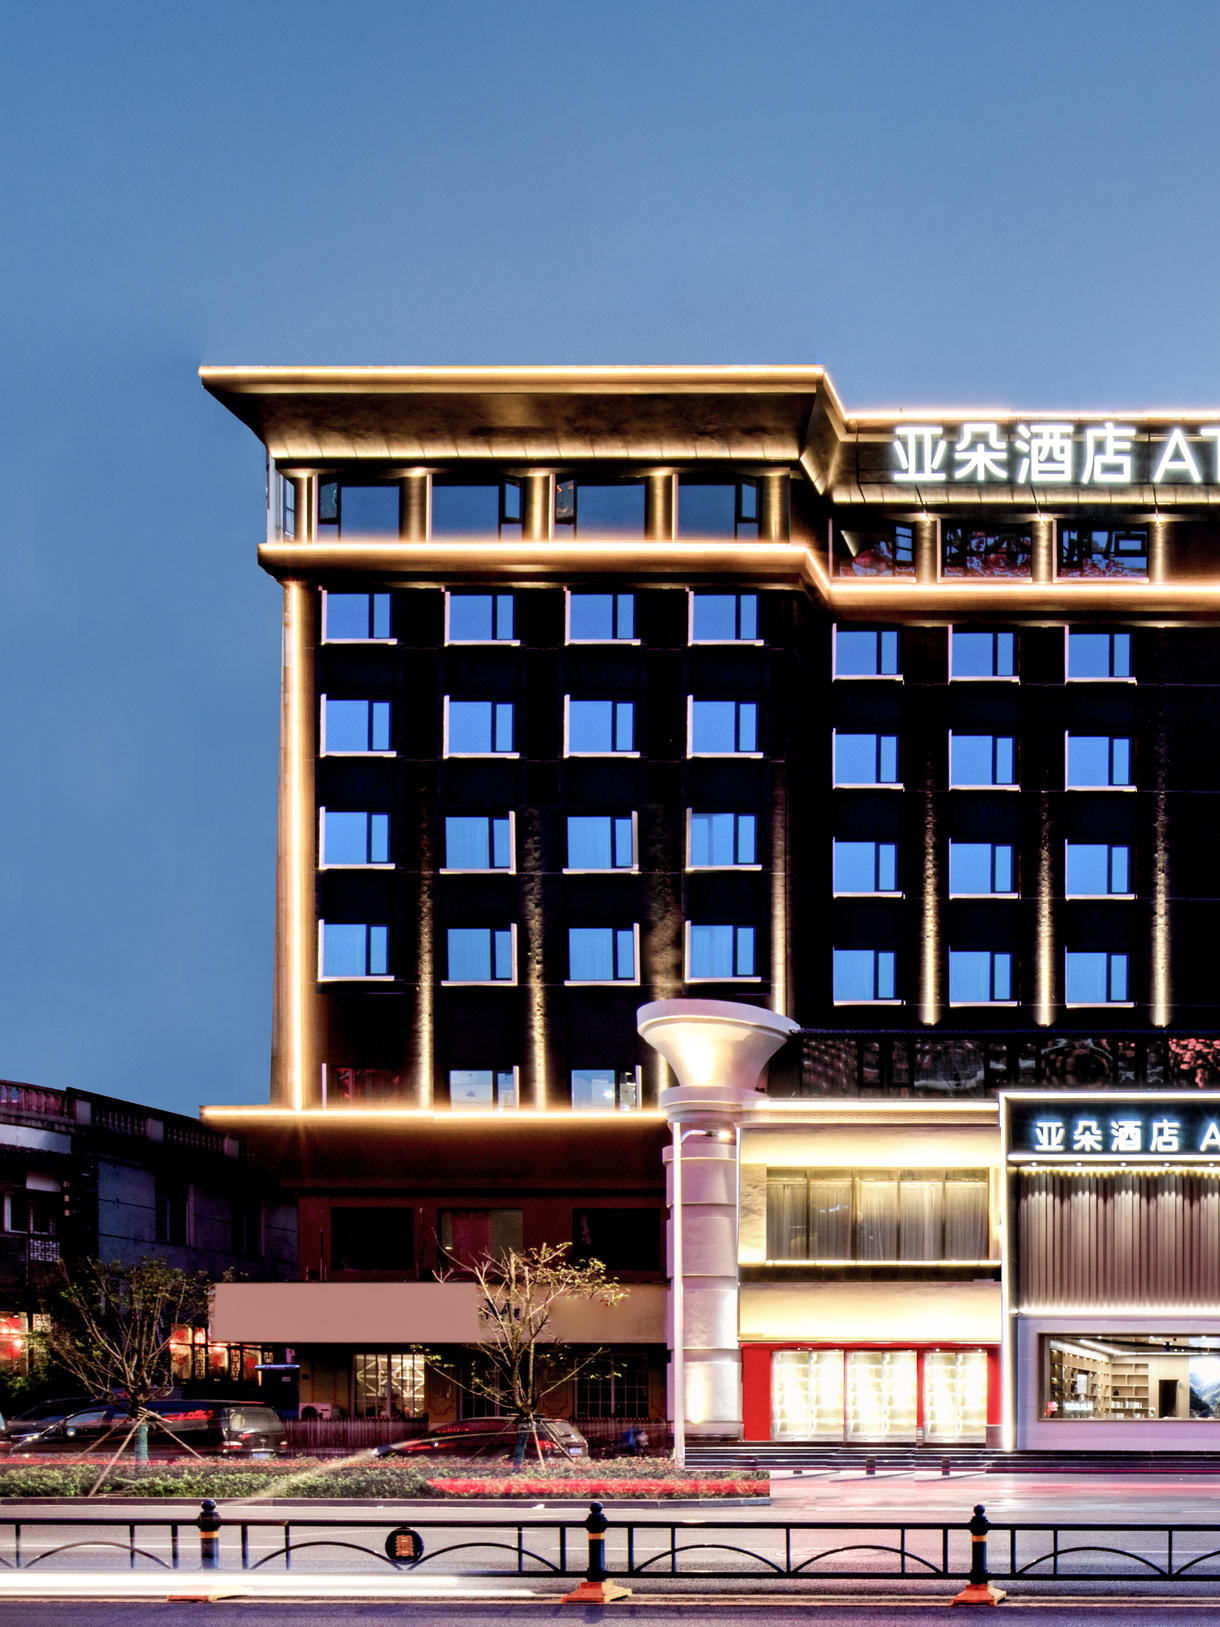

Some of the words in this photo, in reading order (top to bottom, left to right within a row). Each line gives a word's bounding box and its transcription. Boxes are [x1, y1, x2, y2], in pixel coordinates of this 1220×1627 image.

[893, 422, 1136, 484] 亚朵酒店
[1035, 1119, 1181, 1152] 亚朵酒店
